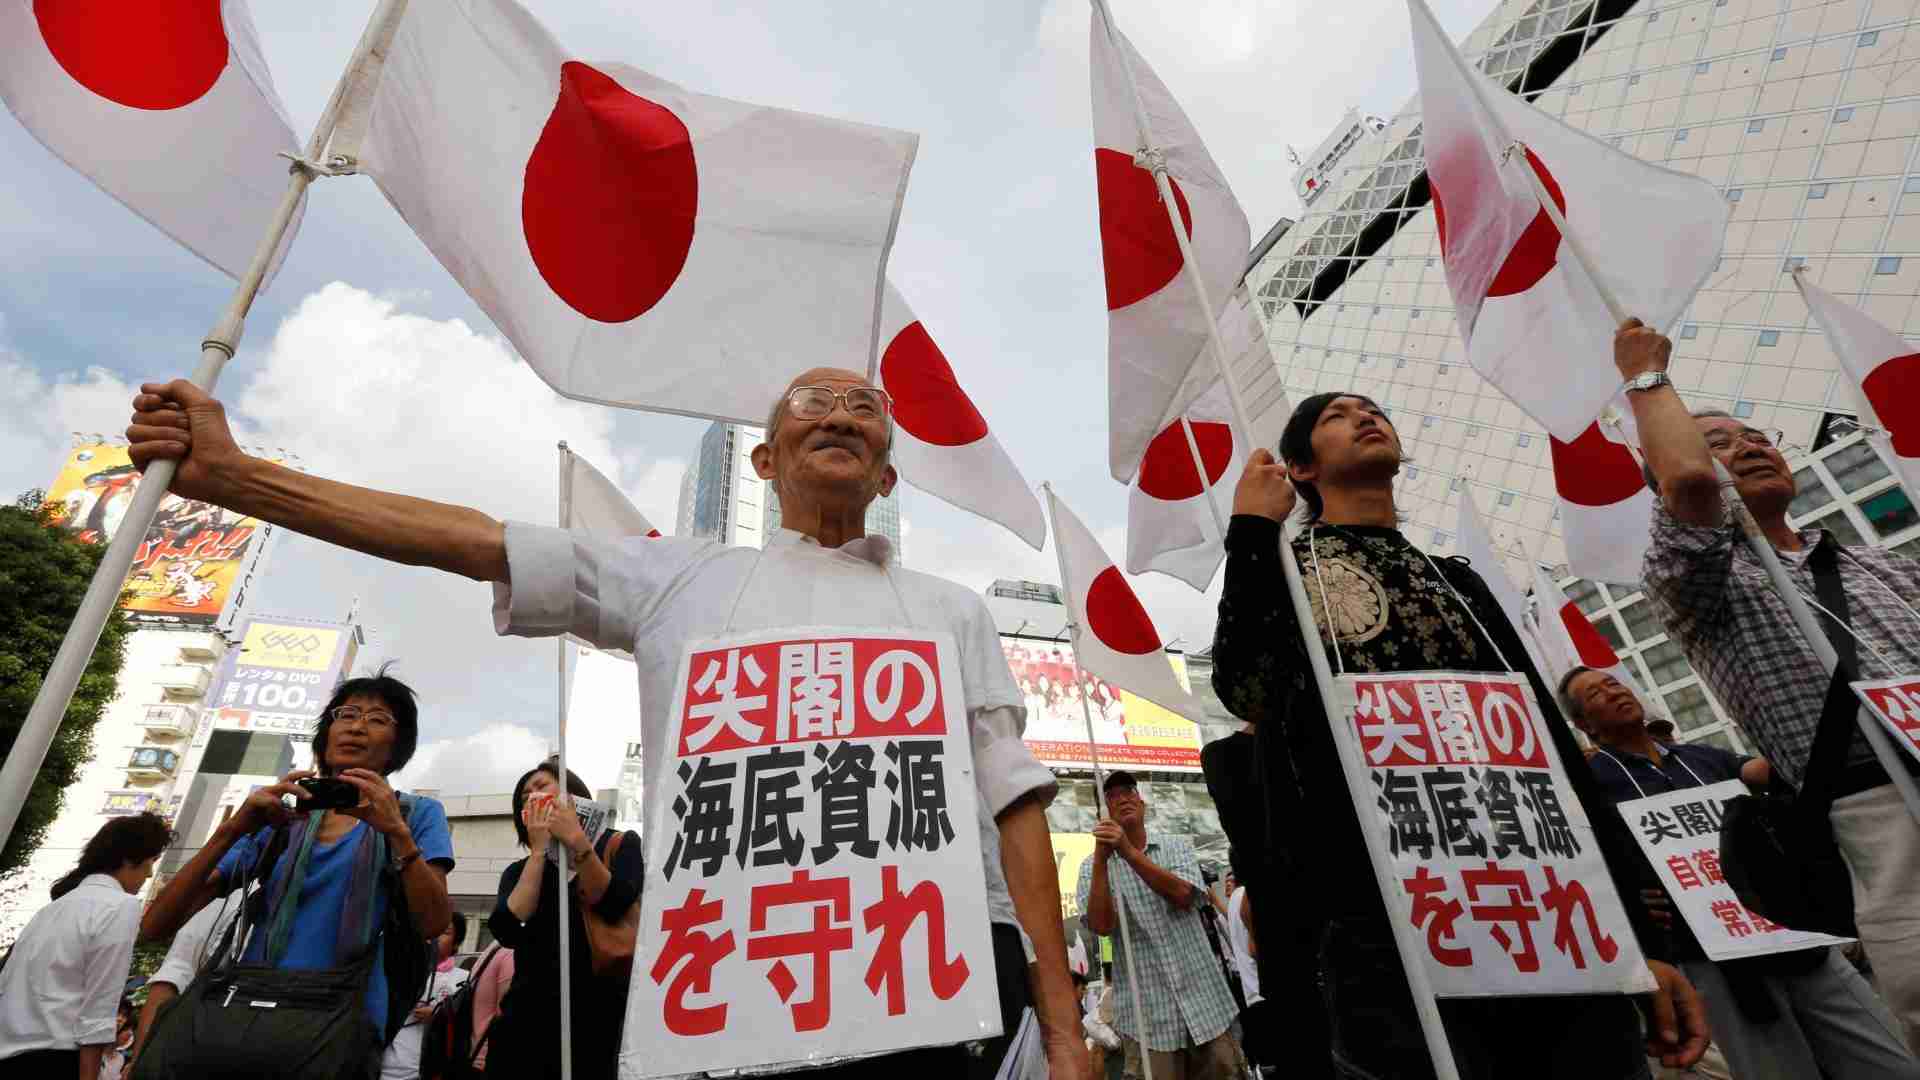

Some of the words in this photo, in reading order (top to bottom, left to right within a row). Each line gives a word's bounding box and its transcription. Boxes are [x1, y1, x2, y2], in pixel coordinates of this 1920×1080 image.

[260, 630, 321, 652] GEO
[242, 683, 307, 708] 100
[685, 641, 937, 754] 尖閣の
[1356, 683, 1535, 763] 尖閣の
[662, 740, 956, 882] 海底資源
[1371, 767, 1582, 860] 海底資源
[650, 865, 970, 1036] を守れ
[1402, 861, 1619, 973] を守れ
